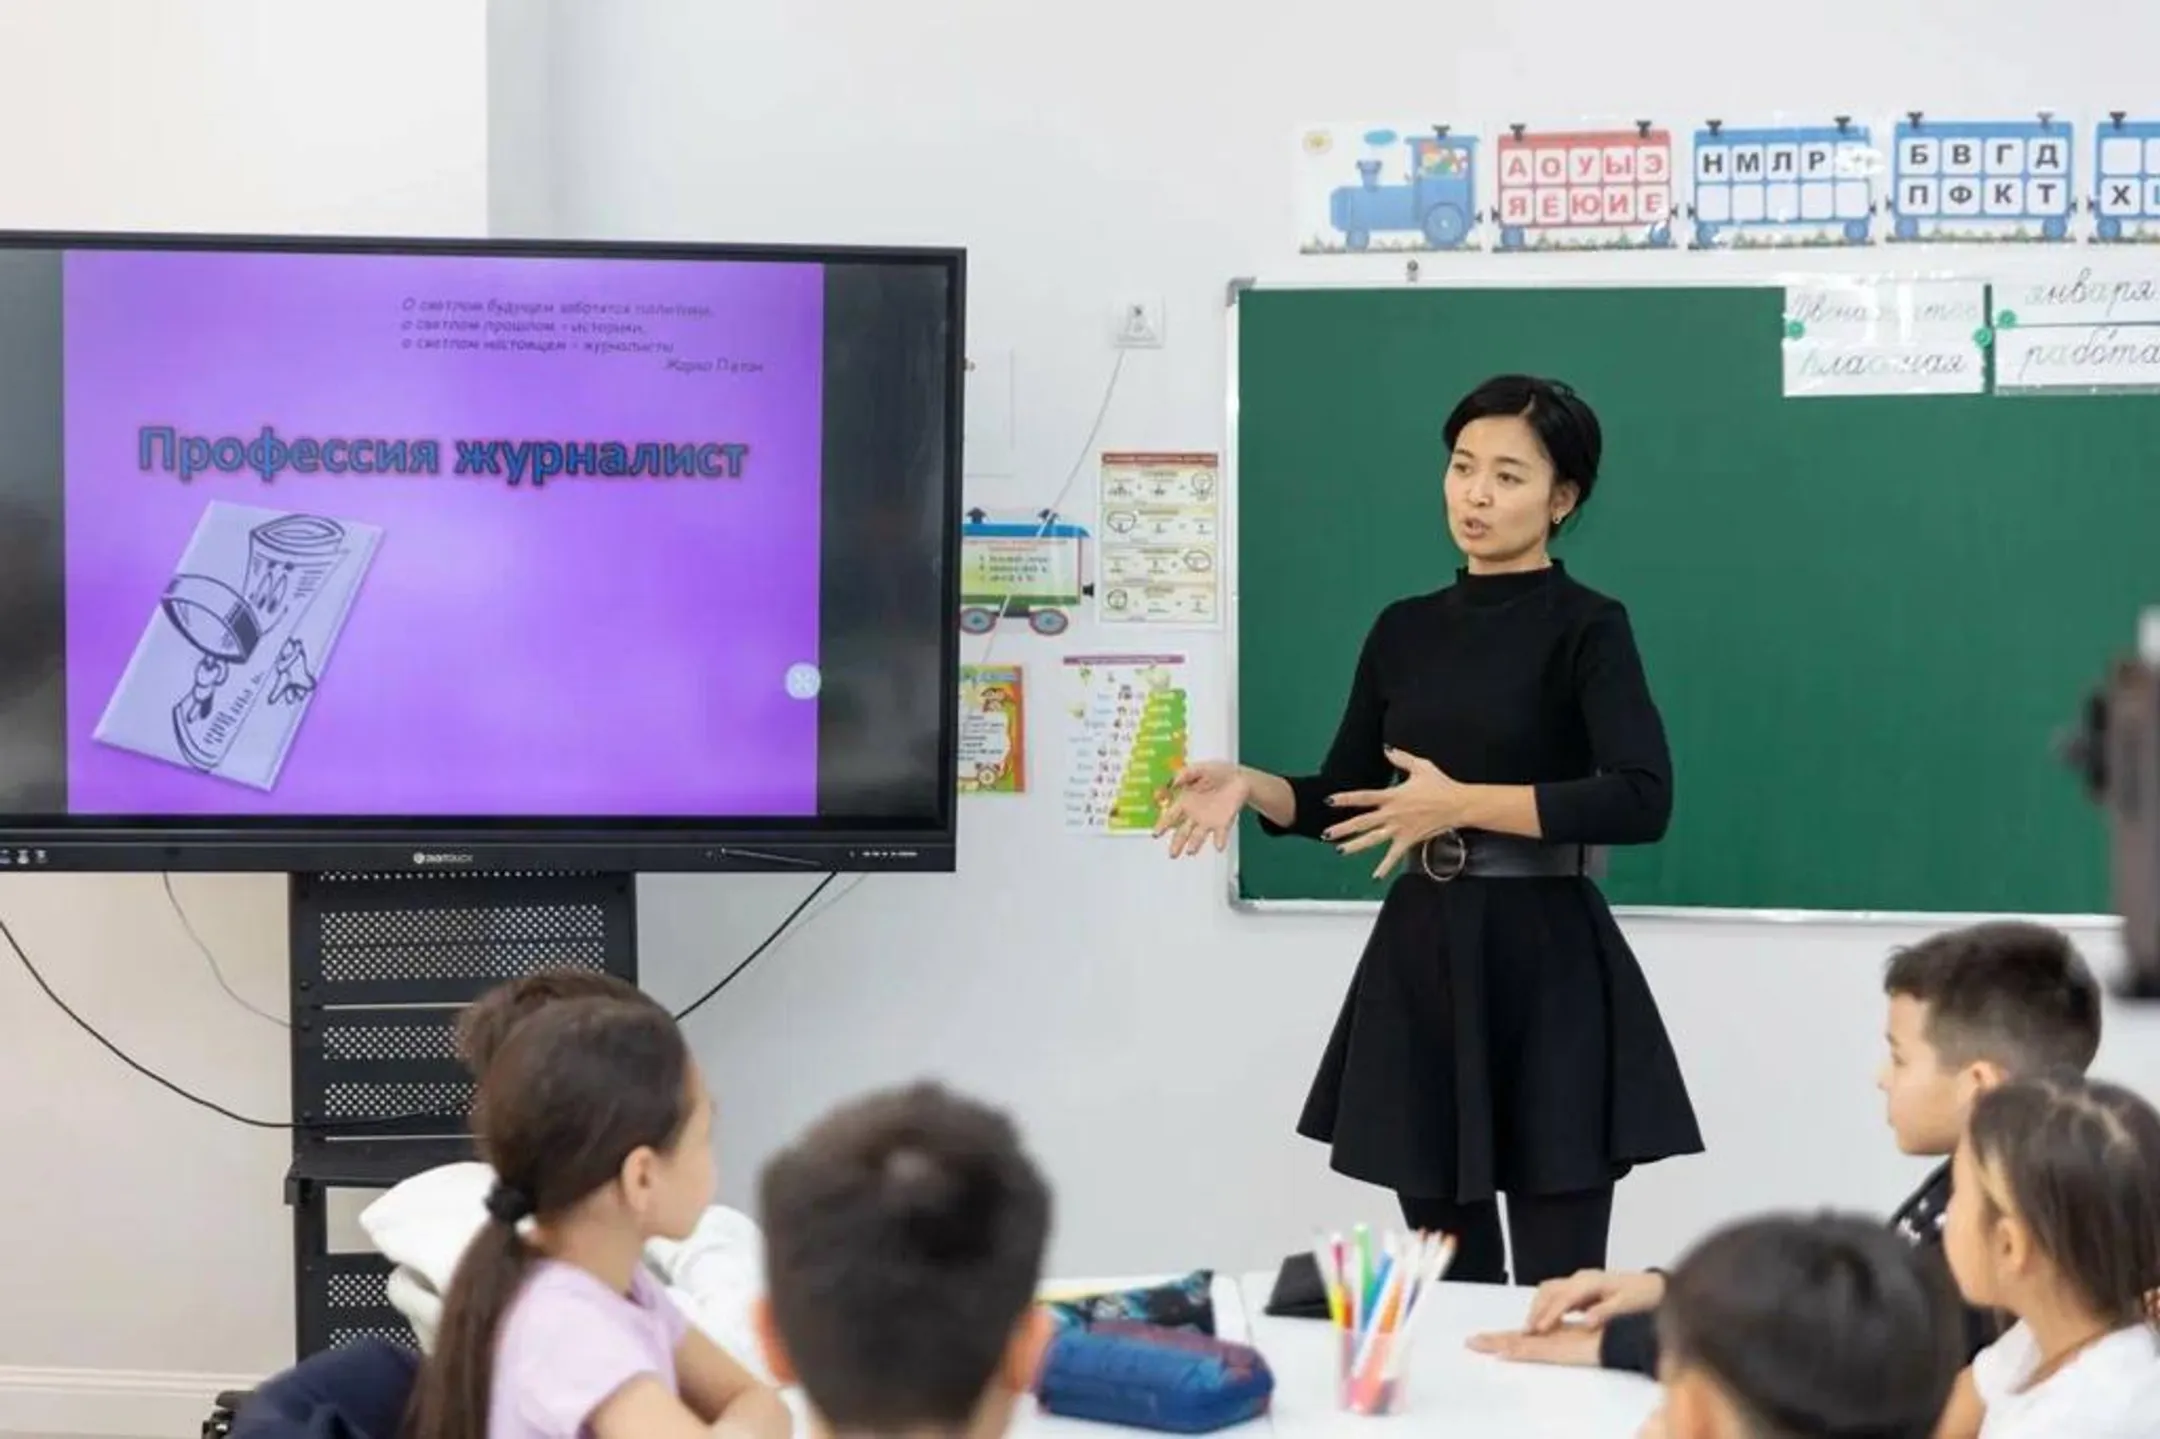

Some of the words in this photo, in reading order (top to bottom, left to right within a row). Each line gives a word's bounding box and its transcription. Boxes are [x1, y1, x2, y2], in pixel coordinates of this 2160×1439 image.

[1508, 156, 1529, 177] А
[1541, 156, 1562, 177] О
[1577, 155, 1595, 177] У
[1605, 154, 1633, 175] Ы
[1644, 154, 1664, 175] Э
[1704, 152, 1723, 173] Н
[1736, 151, 1760, 172] М
[1772, 151, 1793, 172] Л
[1808, 150, 1826, 171] Р
[1910, 144, 1929, 165] Б
[1952, 143, 1972, 165] В
[1996, 143, 2013, 165] Г
[2035, 144, 2059, 168] Д
[1507, 196, 1527, 217] Я
[1571, 193, 1600, 215] Ю
[1607, 192, 1629, 215] И
[1908, 184, 1928, 205] П
[1949, 184, 1972, 205] Ф
[1994, 183, 2013, 204] К
[2037, 183, 2057, 205] Т
[2111, 185, 2131, 206] Х
[137, 424, 441, 484] Профессия
[453, 436, 749, 488] журналист
